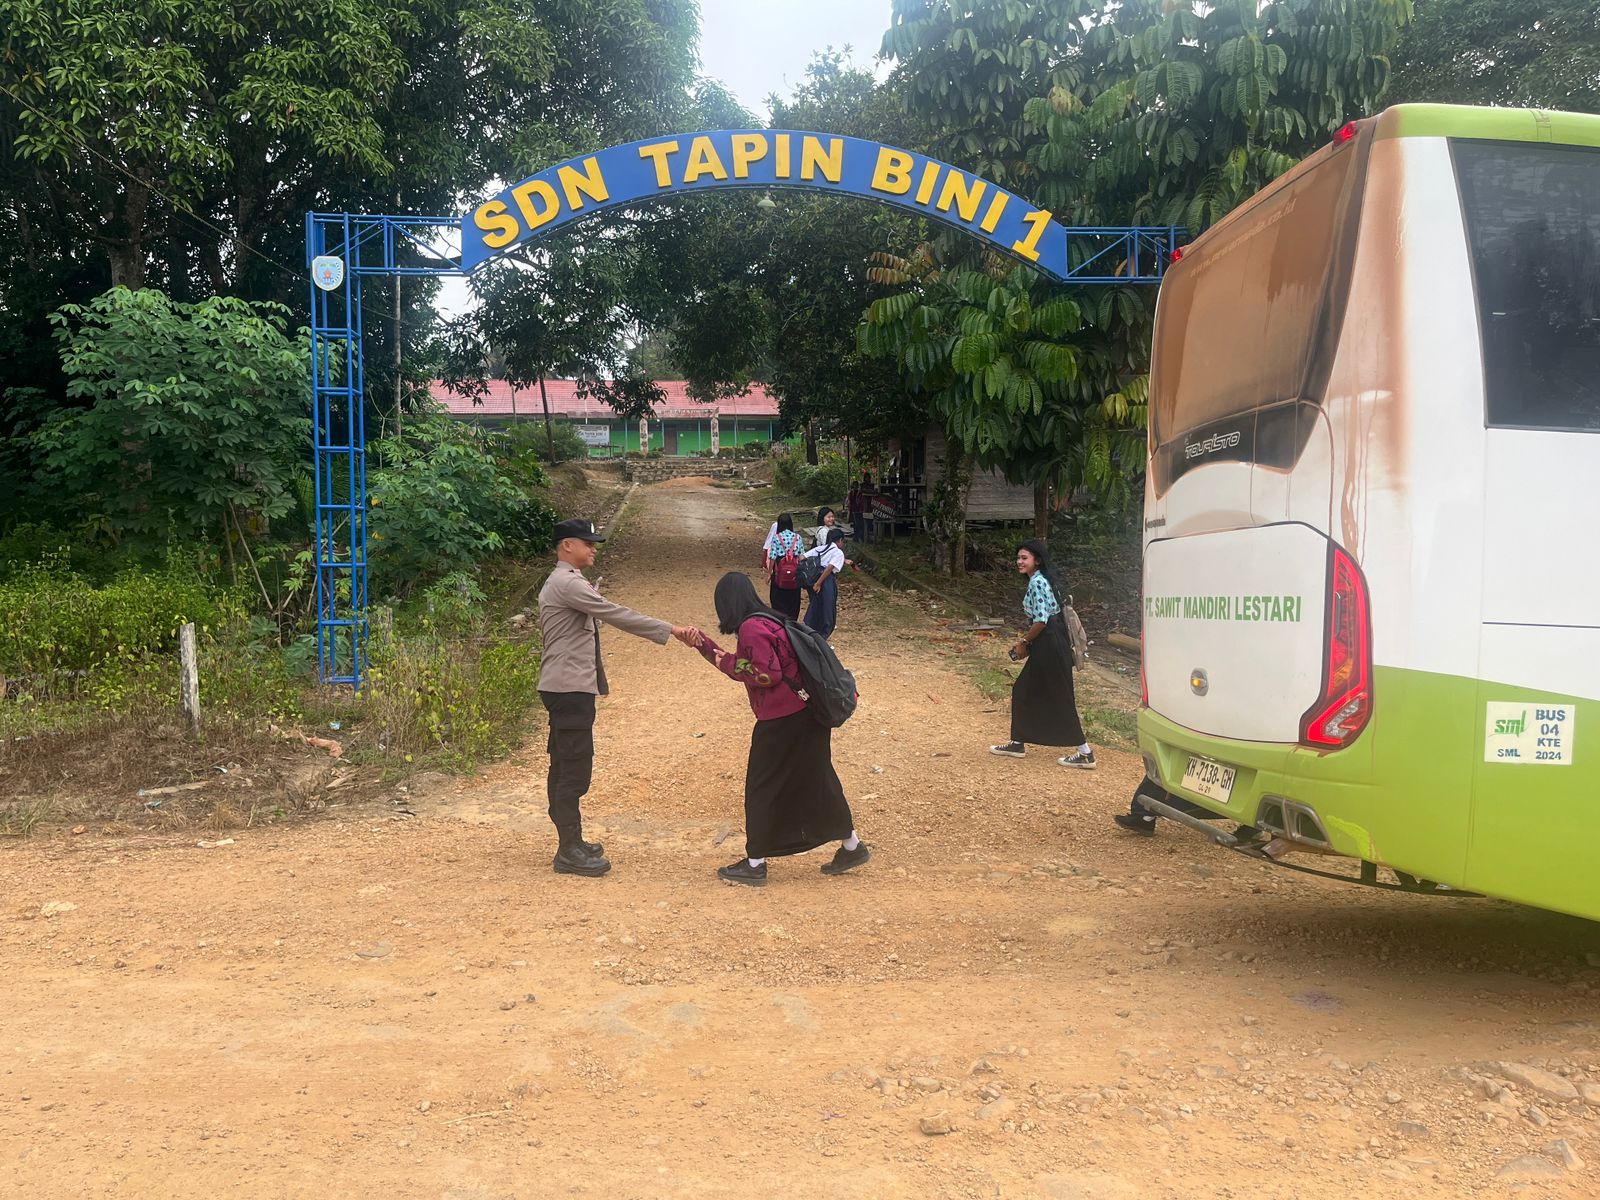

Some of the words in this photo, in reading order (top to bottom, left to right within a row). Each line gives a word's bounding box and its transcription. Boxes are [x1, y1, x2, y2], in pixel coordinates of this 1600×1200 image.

[473, 159, 609, 249] SDN
[639, 133, 844, 188] TAPIN
[870, 146, 1010, 234] BINI
[1012, 209, 1054, 261] 1
[1155, 597, 1181, 618] SAWIT
[1184, 596, 1231, 620] MANDIRI
[1235, 596, 1302, 622] LESTARI
[1535, 709, 1566, 721] BUS
[1540, 723, 1560, 736] 04
[1537, 738, 1561, 747] KTE
[1497, 749, 1521, 757] SML
[1535, 751, 1562, 760] 2024
